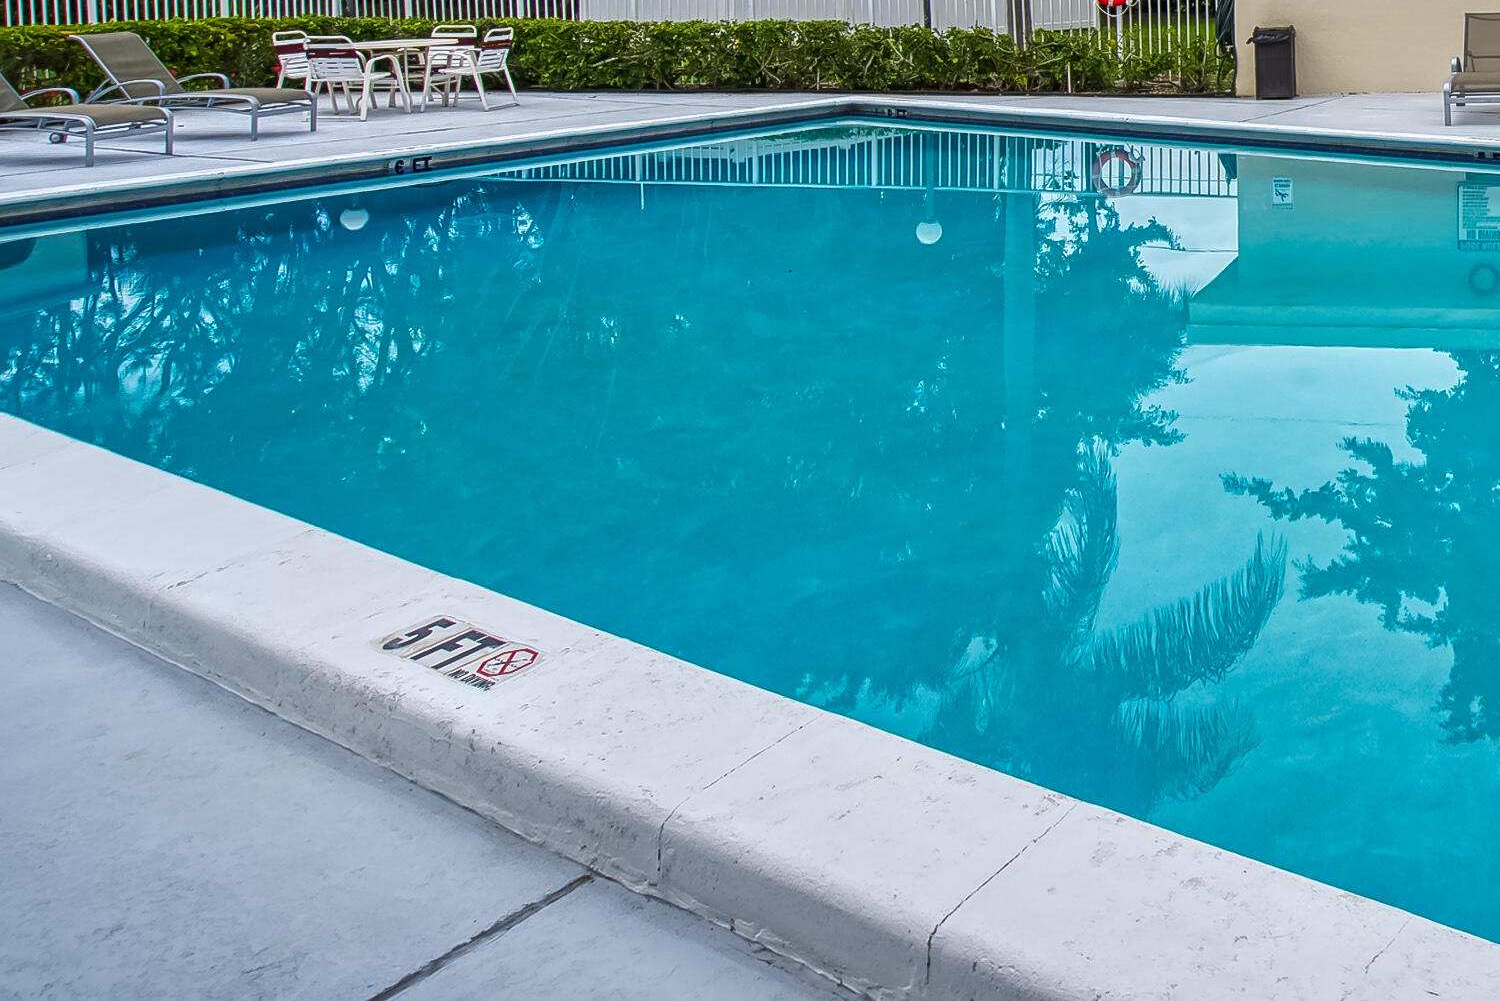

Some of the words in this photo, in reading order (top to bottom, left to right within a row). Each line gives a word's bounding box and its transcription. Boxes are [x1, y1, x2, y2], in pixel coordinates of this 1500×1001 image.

[382, 618, 456, 650] 5
[410, 629, 507, 669] FT
[447, 668, 470, 679] NO
[460, 673, 496, 691] DIVING
